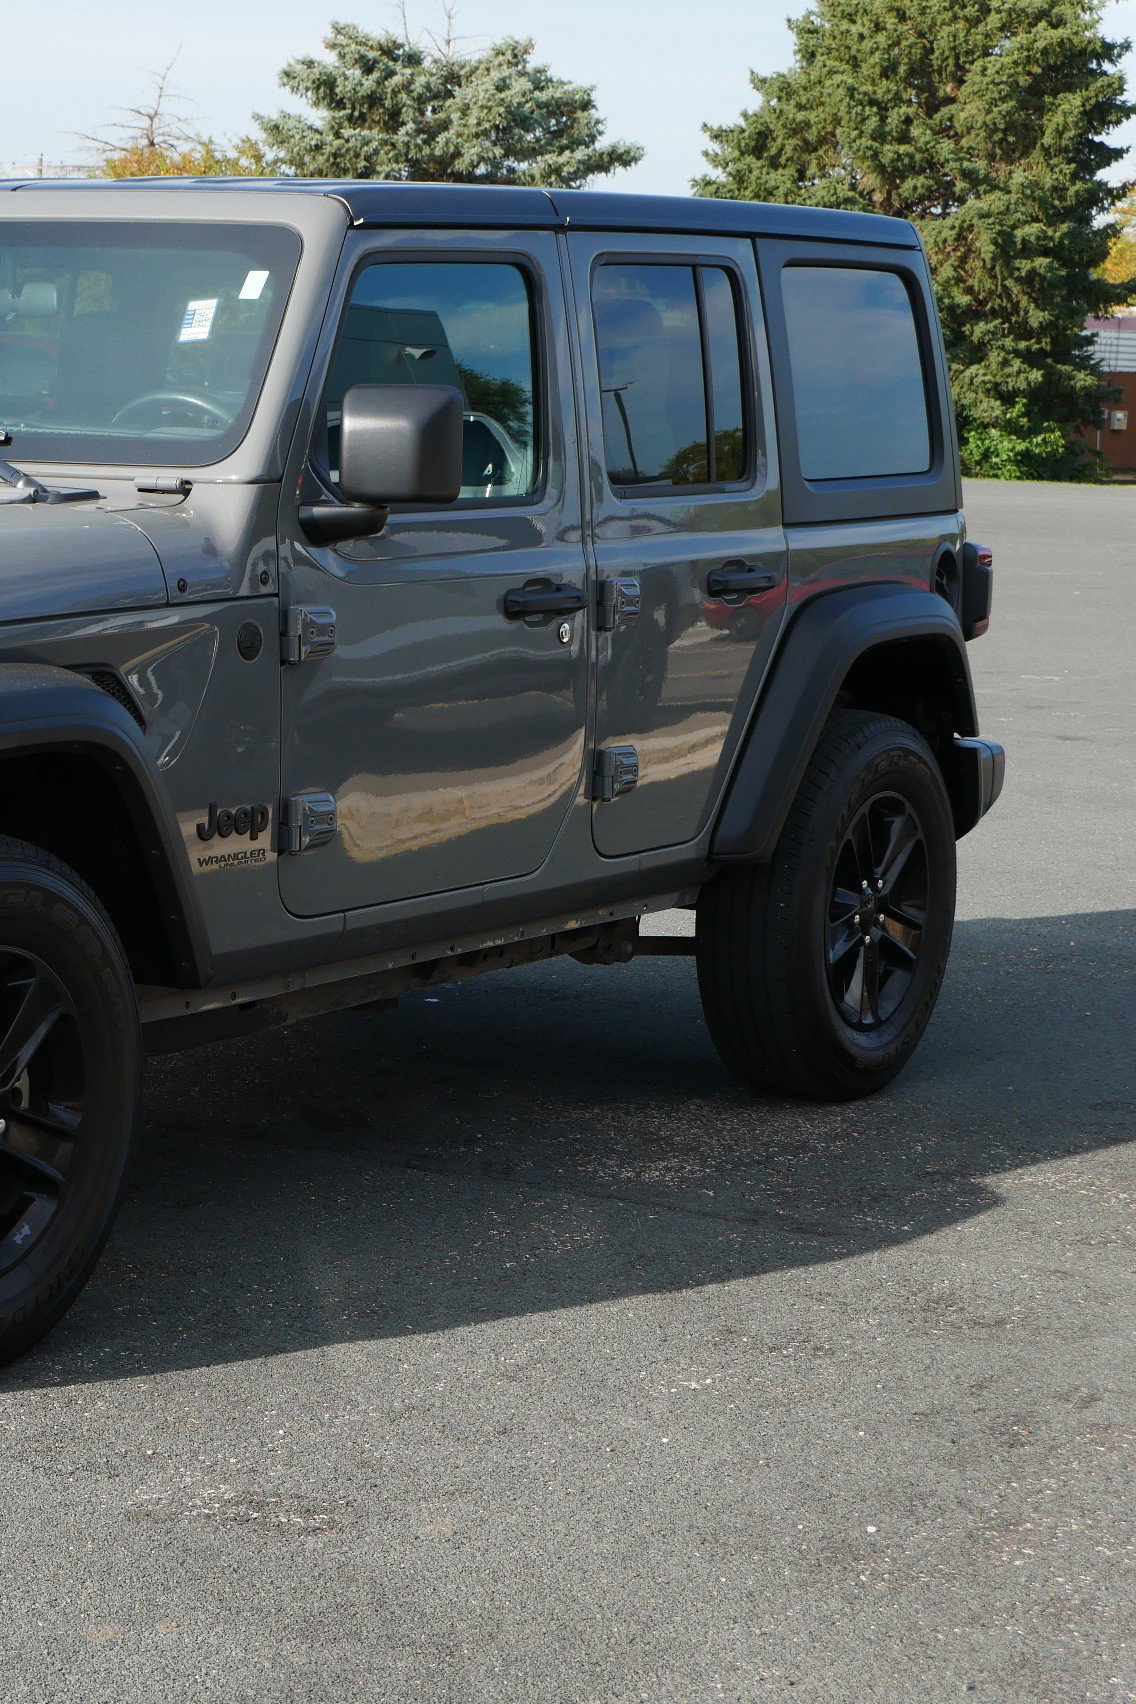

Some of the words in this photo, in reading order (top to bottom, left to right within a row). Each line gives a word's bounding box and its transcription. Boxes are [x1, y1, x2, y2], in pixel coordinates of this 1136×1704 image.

[196, 802, 270, 841] Jeep
[197, 848, 266, 868] WRANGLER
[219, 857, 267, 869] UNLIMITED
